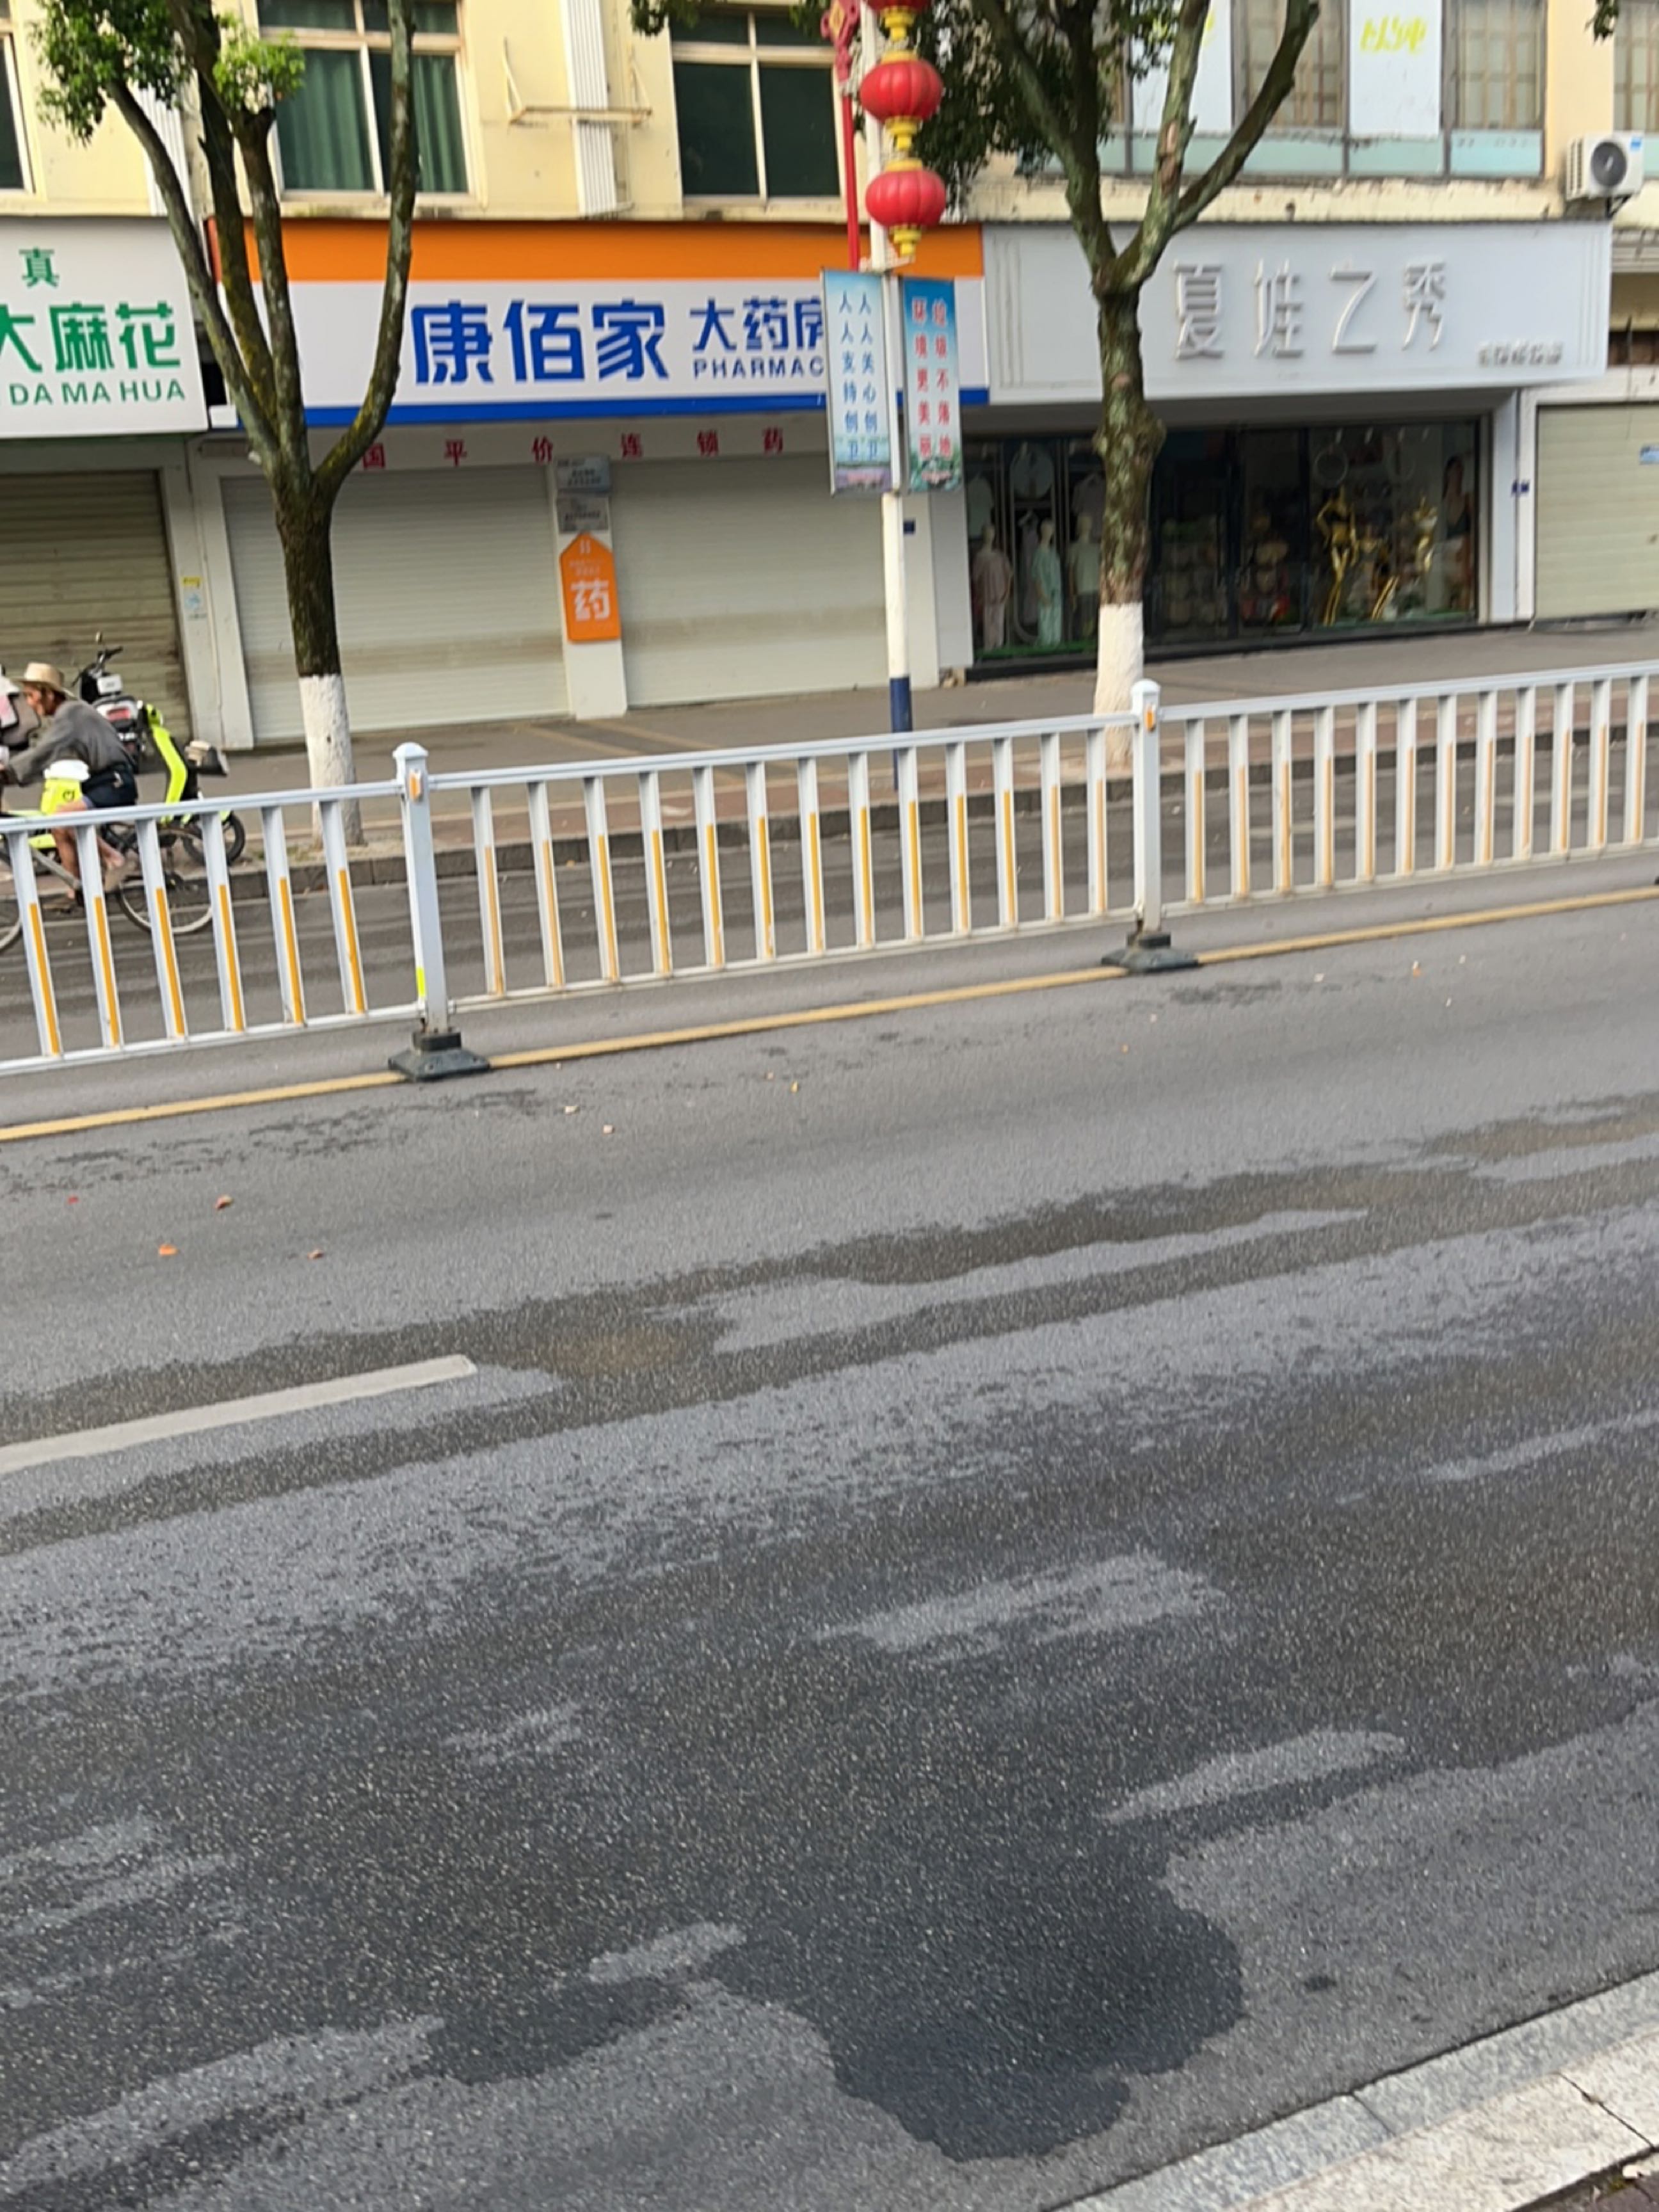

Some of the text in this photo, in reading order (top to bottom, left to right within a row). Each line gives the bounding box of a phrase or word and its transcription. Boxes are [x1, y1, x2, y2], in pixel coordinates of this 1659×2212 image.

[19, 247, 60, 287] 真
[0, 301, 180, 373] 大麻花
[410, 300, 669, 385] 康佰家
[9, 378, 186, 406] DA MA HUA
[838, 291, 859, 461] 人人支持创卫
[858, 292, 878, 461] 人人关心创卫
[570, 578, 611, 621] 药
